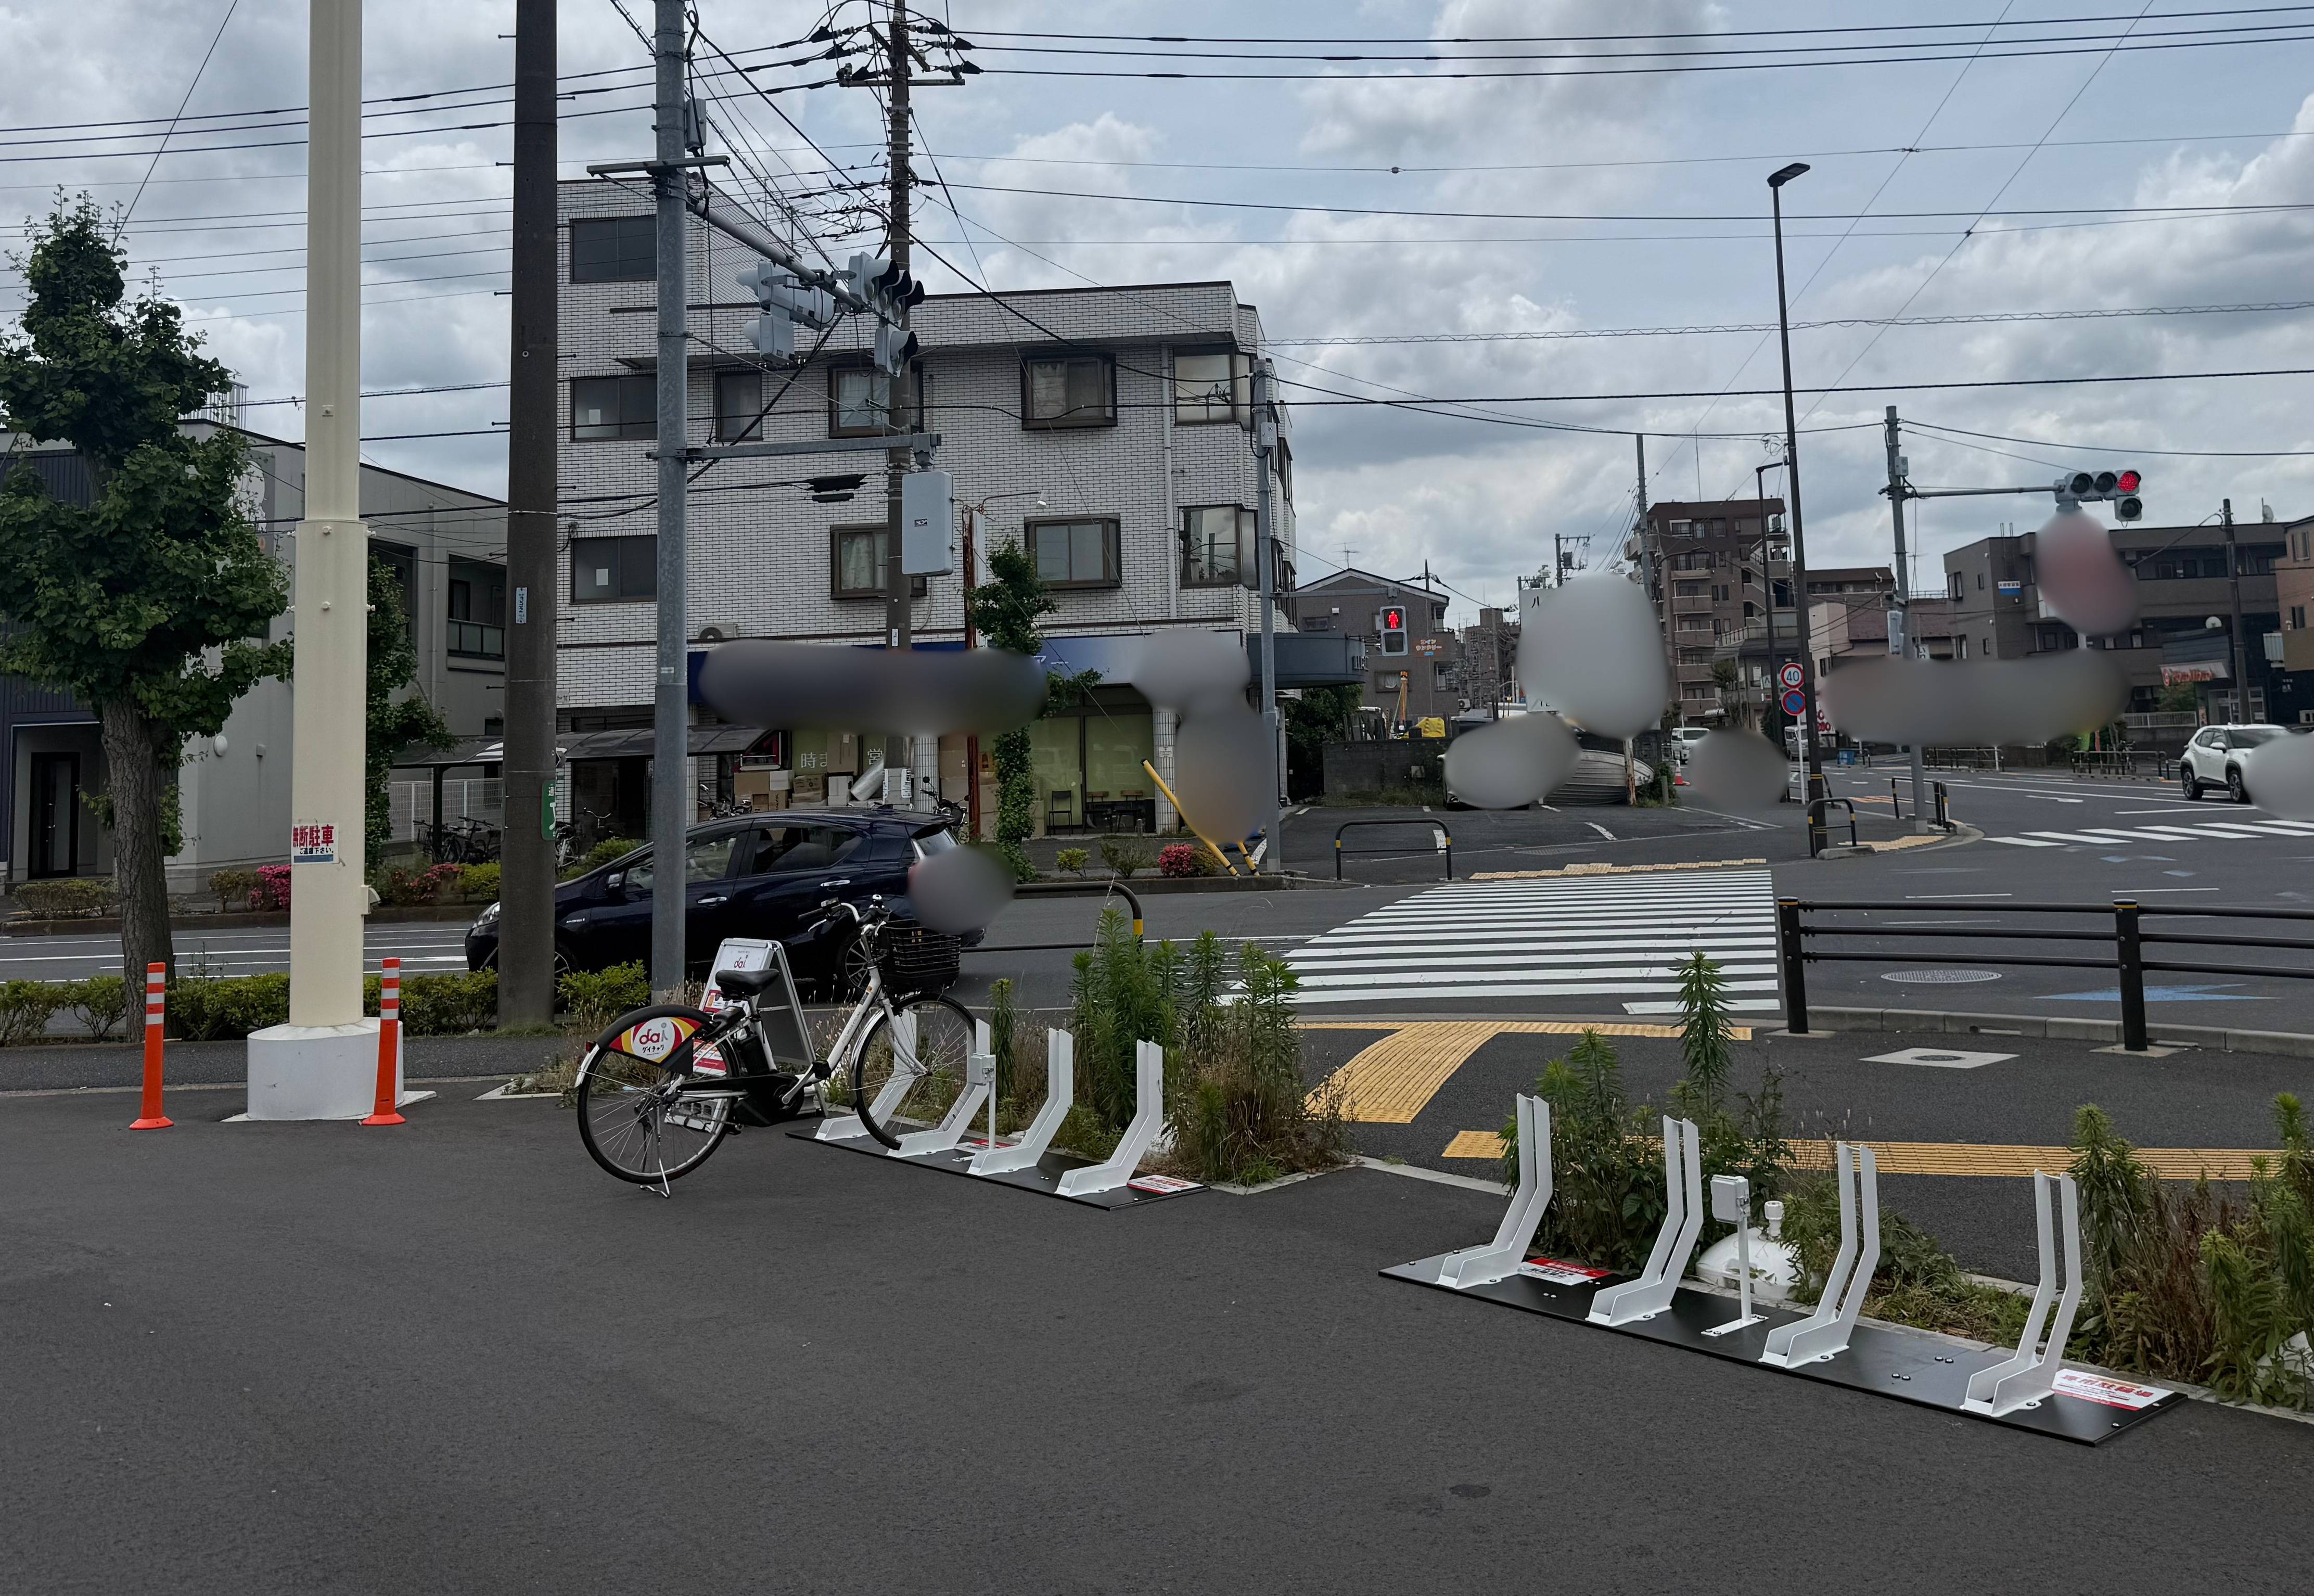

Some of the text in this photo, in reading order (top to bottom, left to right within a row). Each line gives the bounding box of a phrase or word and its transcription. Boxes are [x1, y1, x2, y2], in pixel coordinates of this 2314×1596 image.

[1786, 671, 1800, 682] 40
[292, 824, 334, 848] 無断駐車
[734, 954, 748, 968] dai
[639, 1022, 668, 1045] dai
